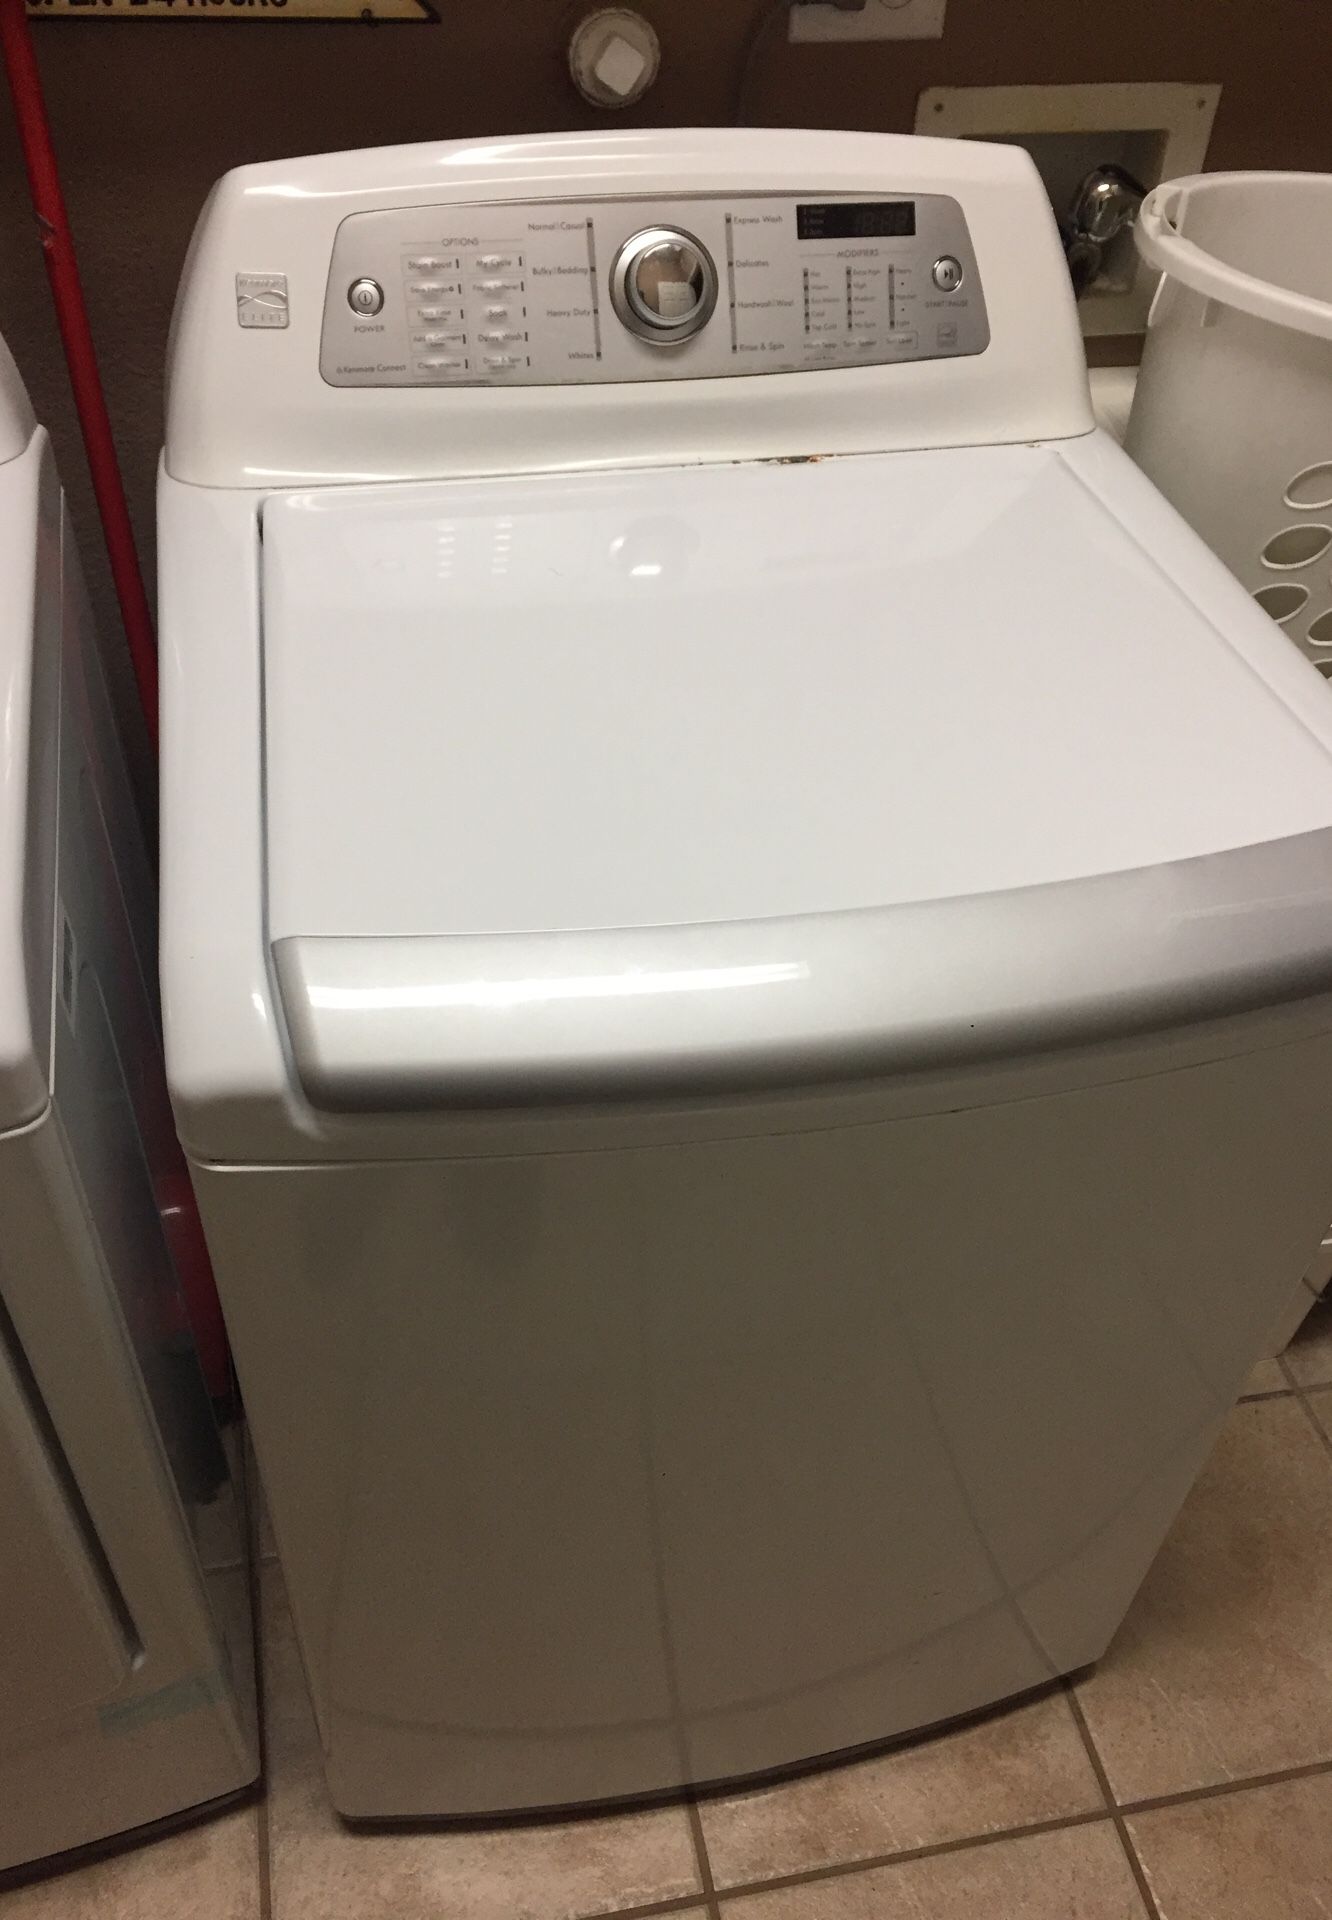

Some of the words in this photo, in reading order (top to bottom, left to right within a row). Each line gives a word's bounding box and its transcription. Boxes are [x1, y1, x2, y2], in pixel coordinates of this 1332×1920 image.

[733, 216, 760, 225] Express
[762, 215, 783, 223] Wash
[442, 237, 479, 247] OPTIONS
[837, 249, 879, 258] MODIFIERS
[736, 260, 769, 268] Delicates
[532, 267, 552, 276] Bulky
[557, 266, 588, 276] Bedding
[547, 310, 570, 318] Heavy
[573, 308, 590, 317] Duty
[354, 324, 385, 333] POWER
[740, 343, 758, 352] Rinse
[769, 341, 785, 352] Spin
[568, 352, 594, 360] Whites
[343, 366, 375, 374] Kenmore
[376, 364, 406, 373] Connect
